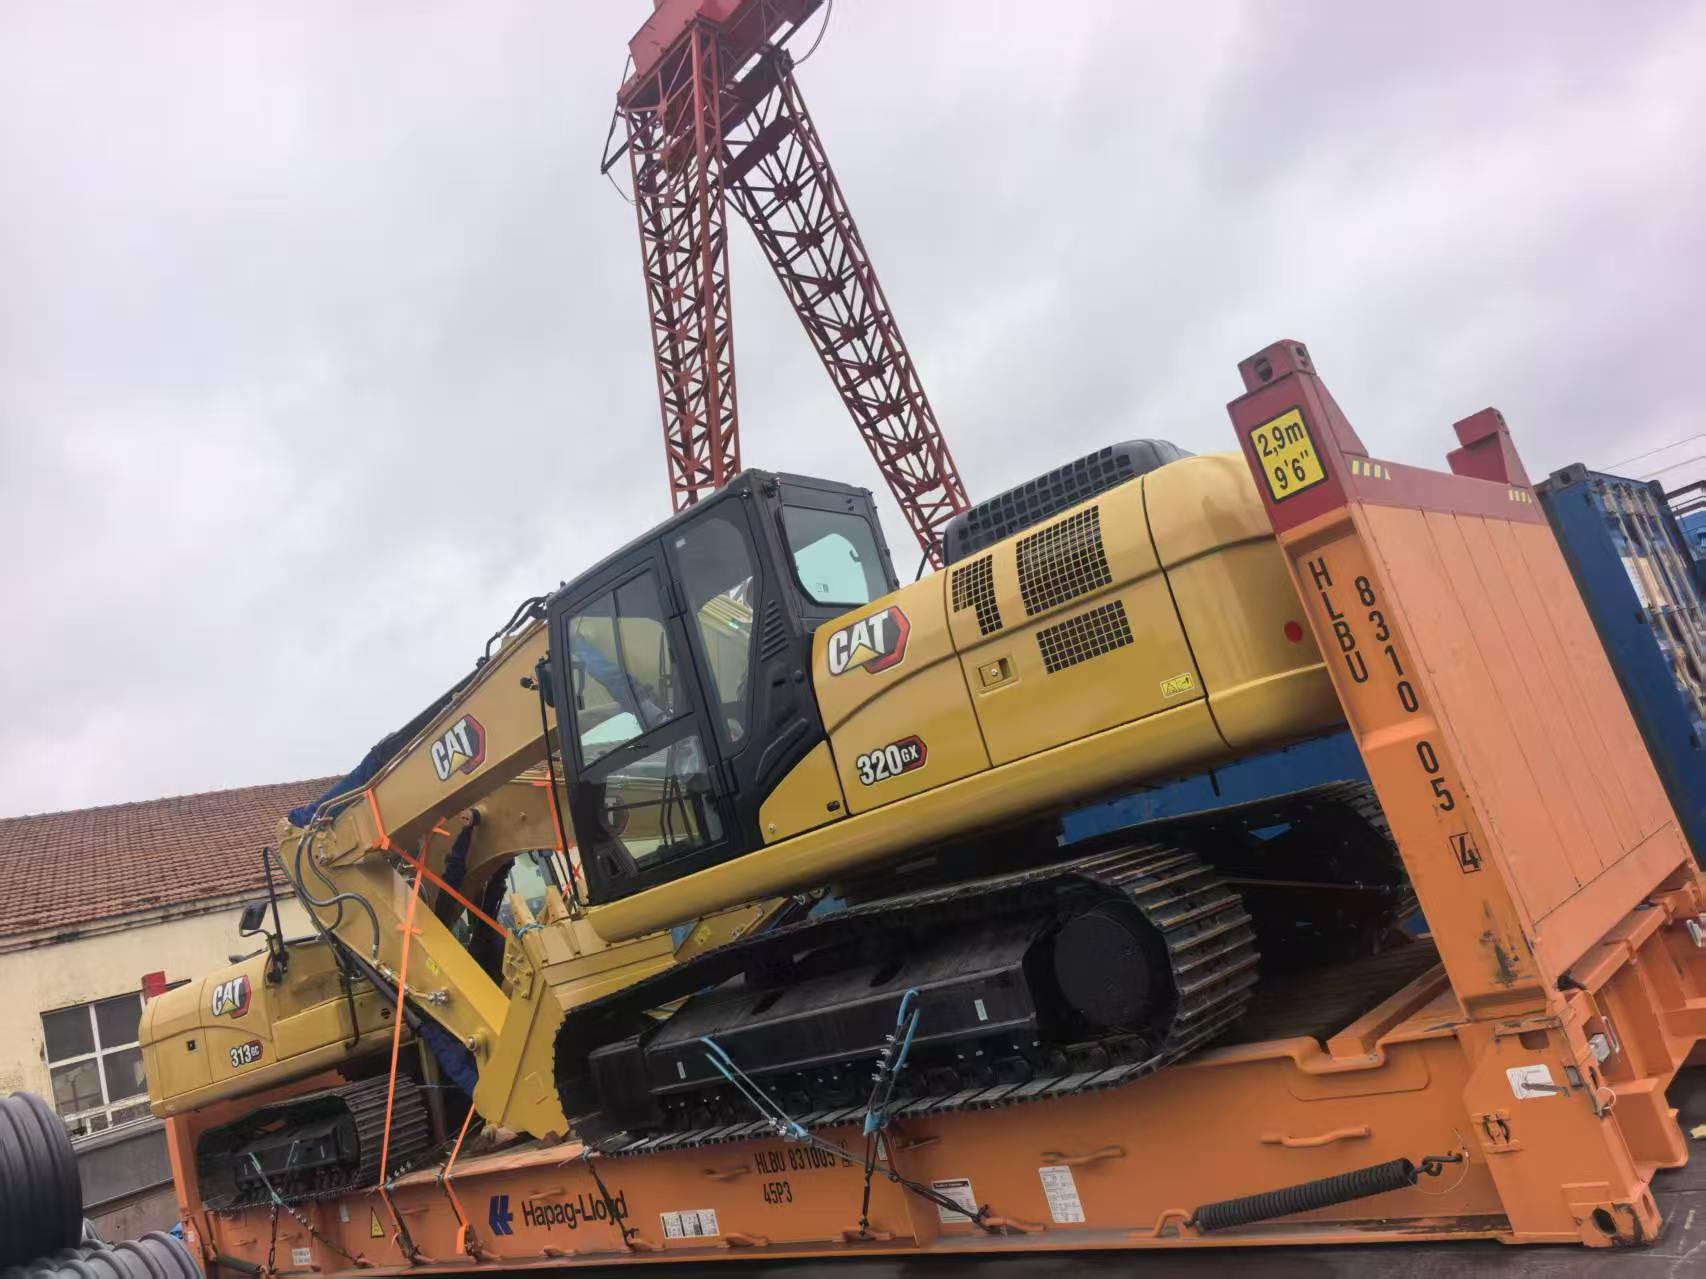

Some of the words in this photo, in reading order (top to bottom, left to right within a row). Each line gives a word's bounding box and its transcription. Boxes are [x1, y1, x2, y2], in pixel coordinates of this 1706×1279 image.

[1308, 557, 1369, 683] HLBU
[828, 610, 889, 676] CAT
[431, 718, 473, 780] CAT
[212, 976, 243, 1016] CAT
[754, 1149, 786, 1174] HLBU
[521, 1189, 629, 1231] Hapag-Lloyd
[763, 1180, 793, 1204] 45P3
